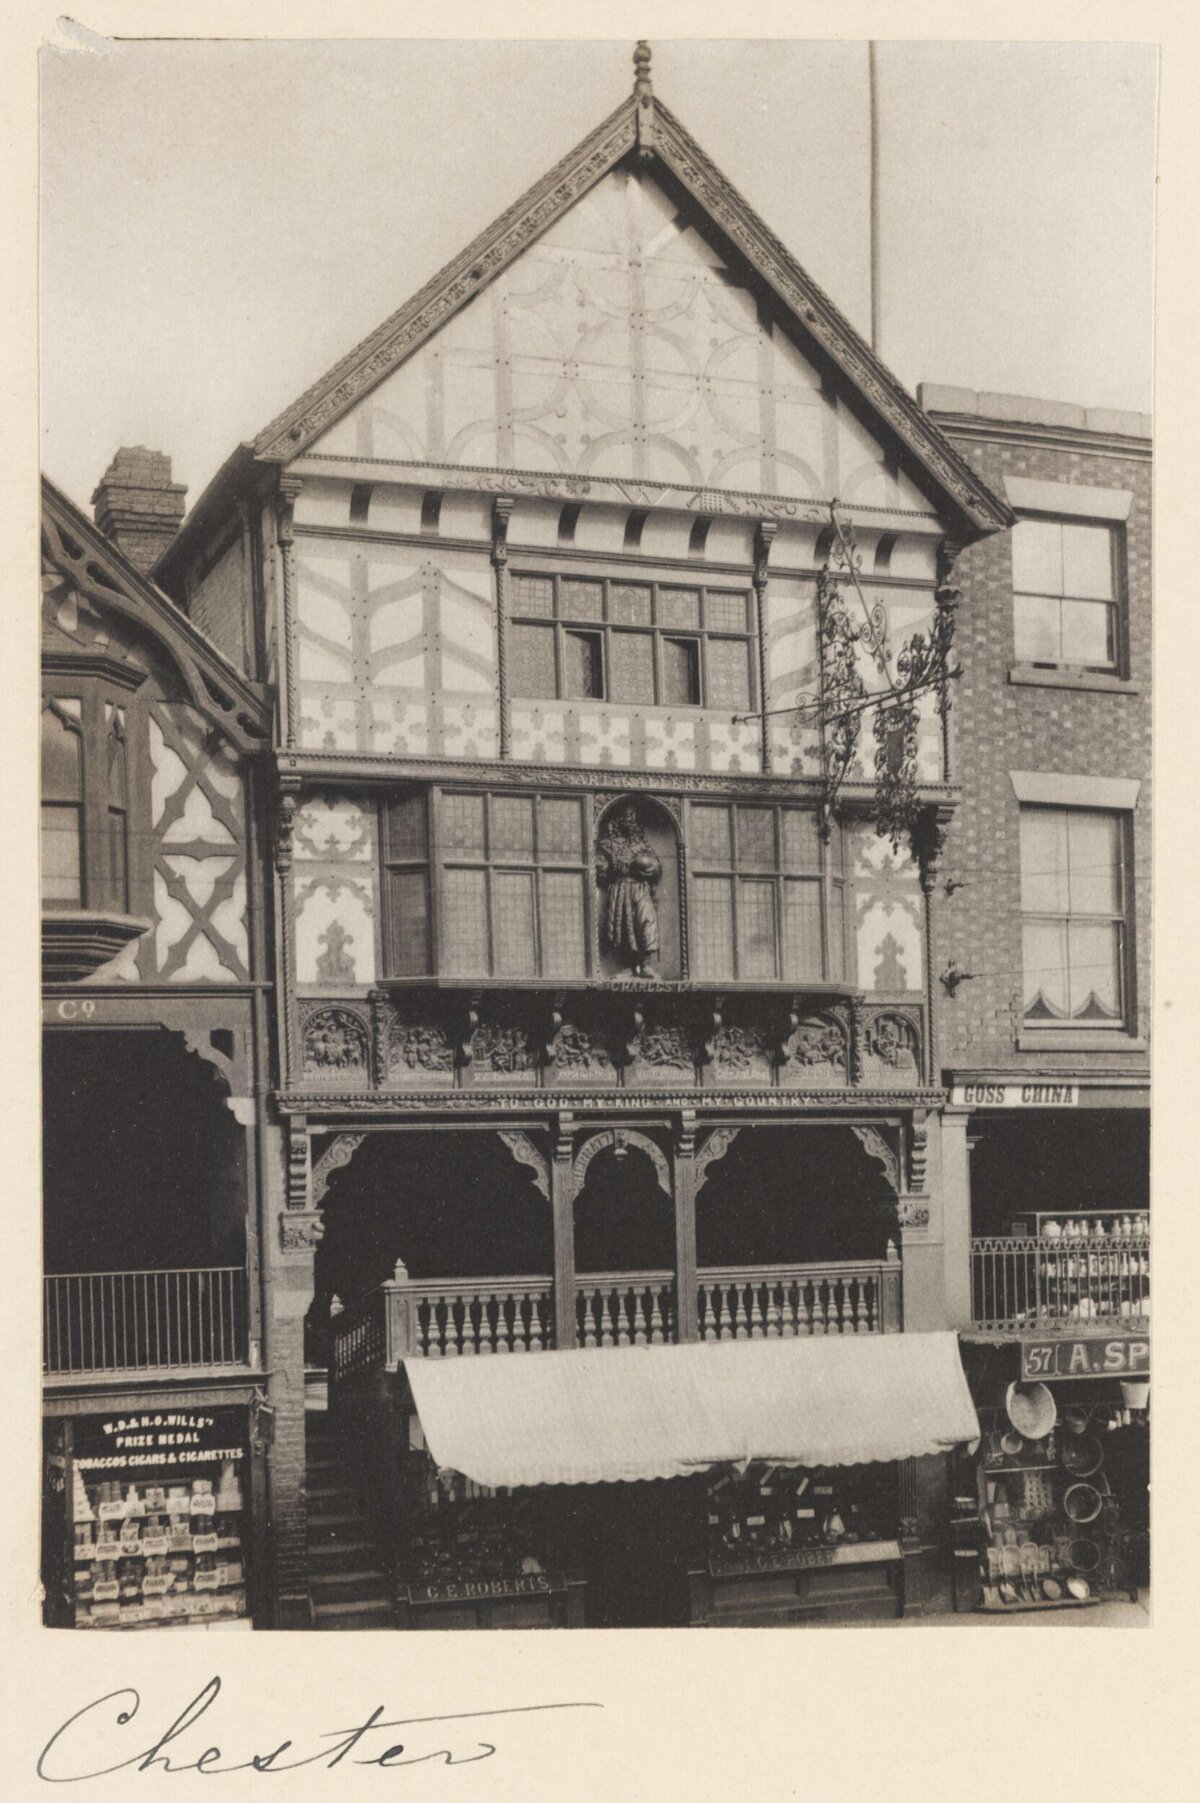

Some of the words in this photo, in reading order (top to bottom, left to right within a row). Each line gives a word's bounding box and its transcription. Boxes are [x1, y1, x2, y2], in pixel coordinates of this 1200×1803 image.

[576, 775, 611, 786] ART
[620, 777, 706, 790] GALLERY
[611, 982, 672, 993] CHARLES
[499, 1098, 519, 1109] TO
[533, 1098, 568, 1109] GOD
[583, 1098, 606, 1109] MY
[615, 1097, 650, 1109] KING
[665, 1098, 688, 1107] AND
[702, 1096, 723, 1108] MY
[733, 1095, 811, 1107] COUNTRY
[964, 1084, 1005, 1104] GOSS
[1021, 1084, 1073, 1104] CHINA
[1028, 1347, 1053, 1373] 57
[116, 1435, 153, 1448] PRIZE
[159, 1432, 200, 1445] MEDAL
[73, 1455, 127, 1469] TOBACCOS
[128, 1453, 167, 1467] CIGARS
[168, 1452, 177, 1463] &
[179, 1448, 244, 1463] CIGARETTES
[464, 1576, 549, 1597] ROBERTS
[37, 1676, 604, 1782] Chester
